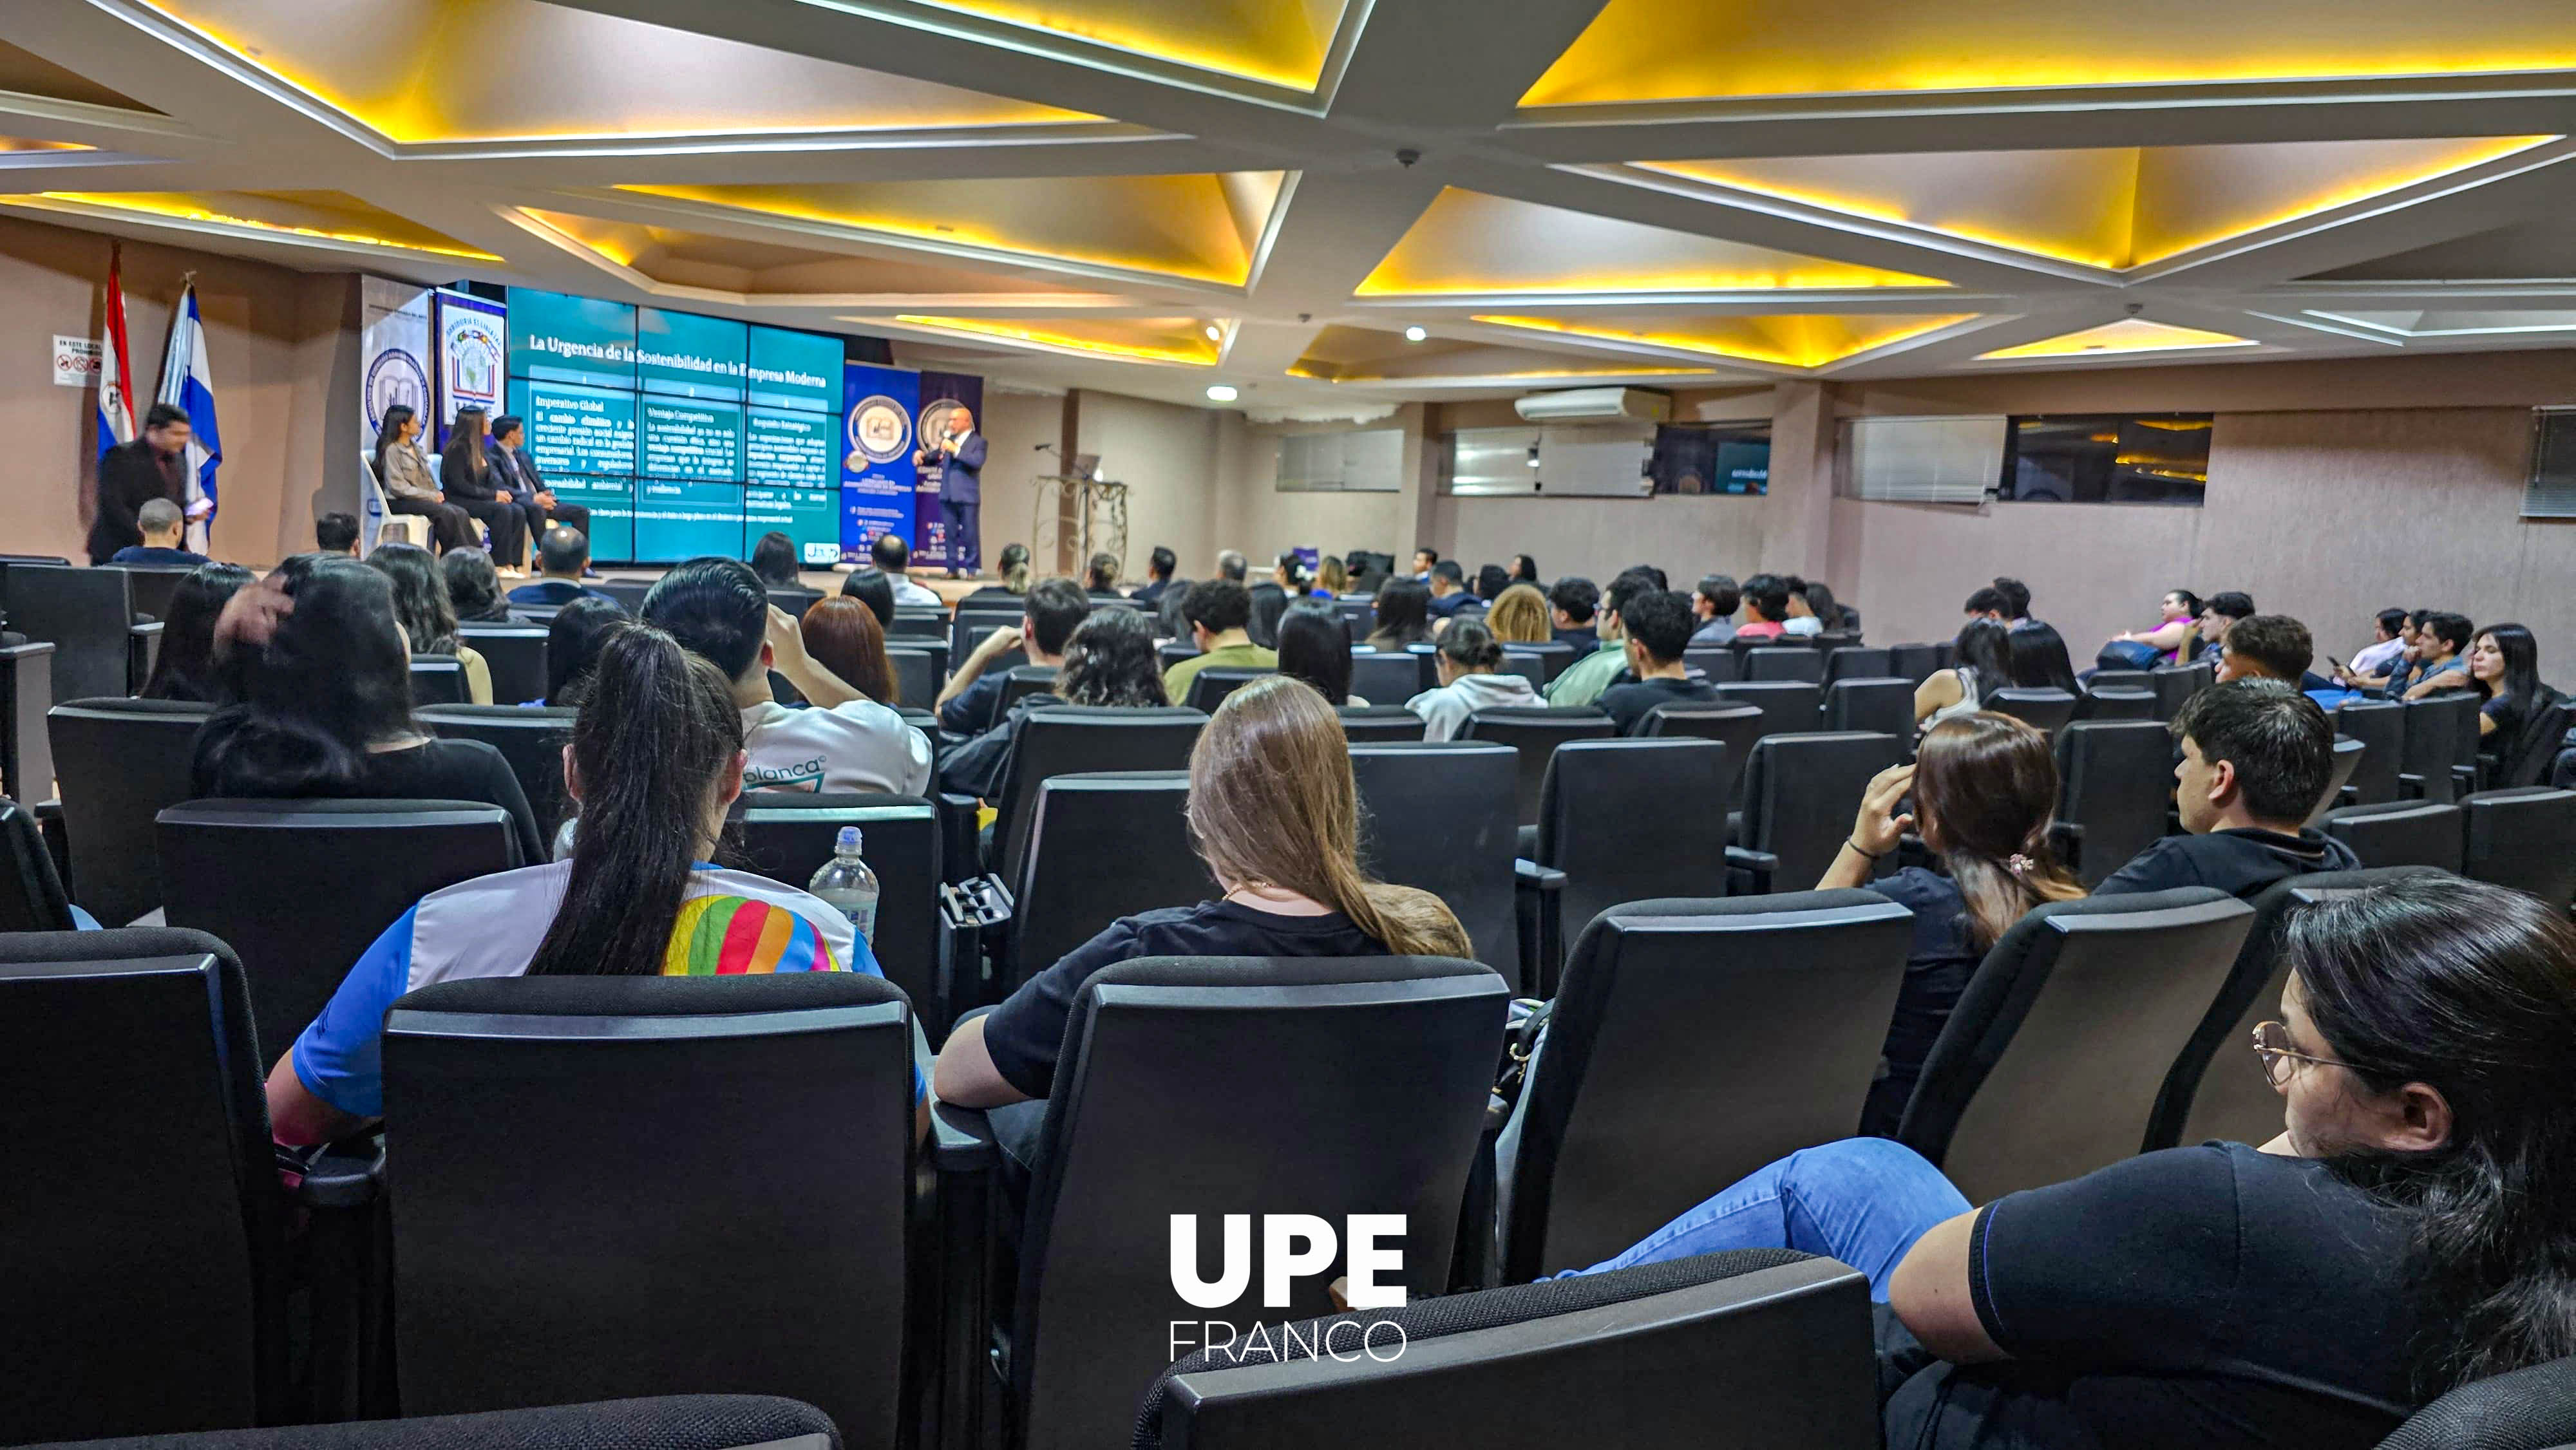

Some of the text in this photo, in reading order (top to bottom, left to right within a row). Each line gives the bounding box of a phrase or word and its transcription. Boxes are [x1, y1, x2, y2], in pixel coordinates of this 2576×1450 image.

[530, 334, 826, 388] La Urgencia de la Sostenibilidad en la Empresa Moderna
[535, 395, 605, 413] Imperativo Global
